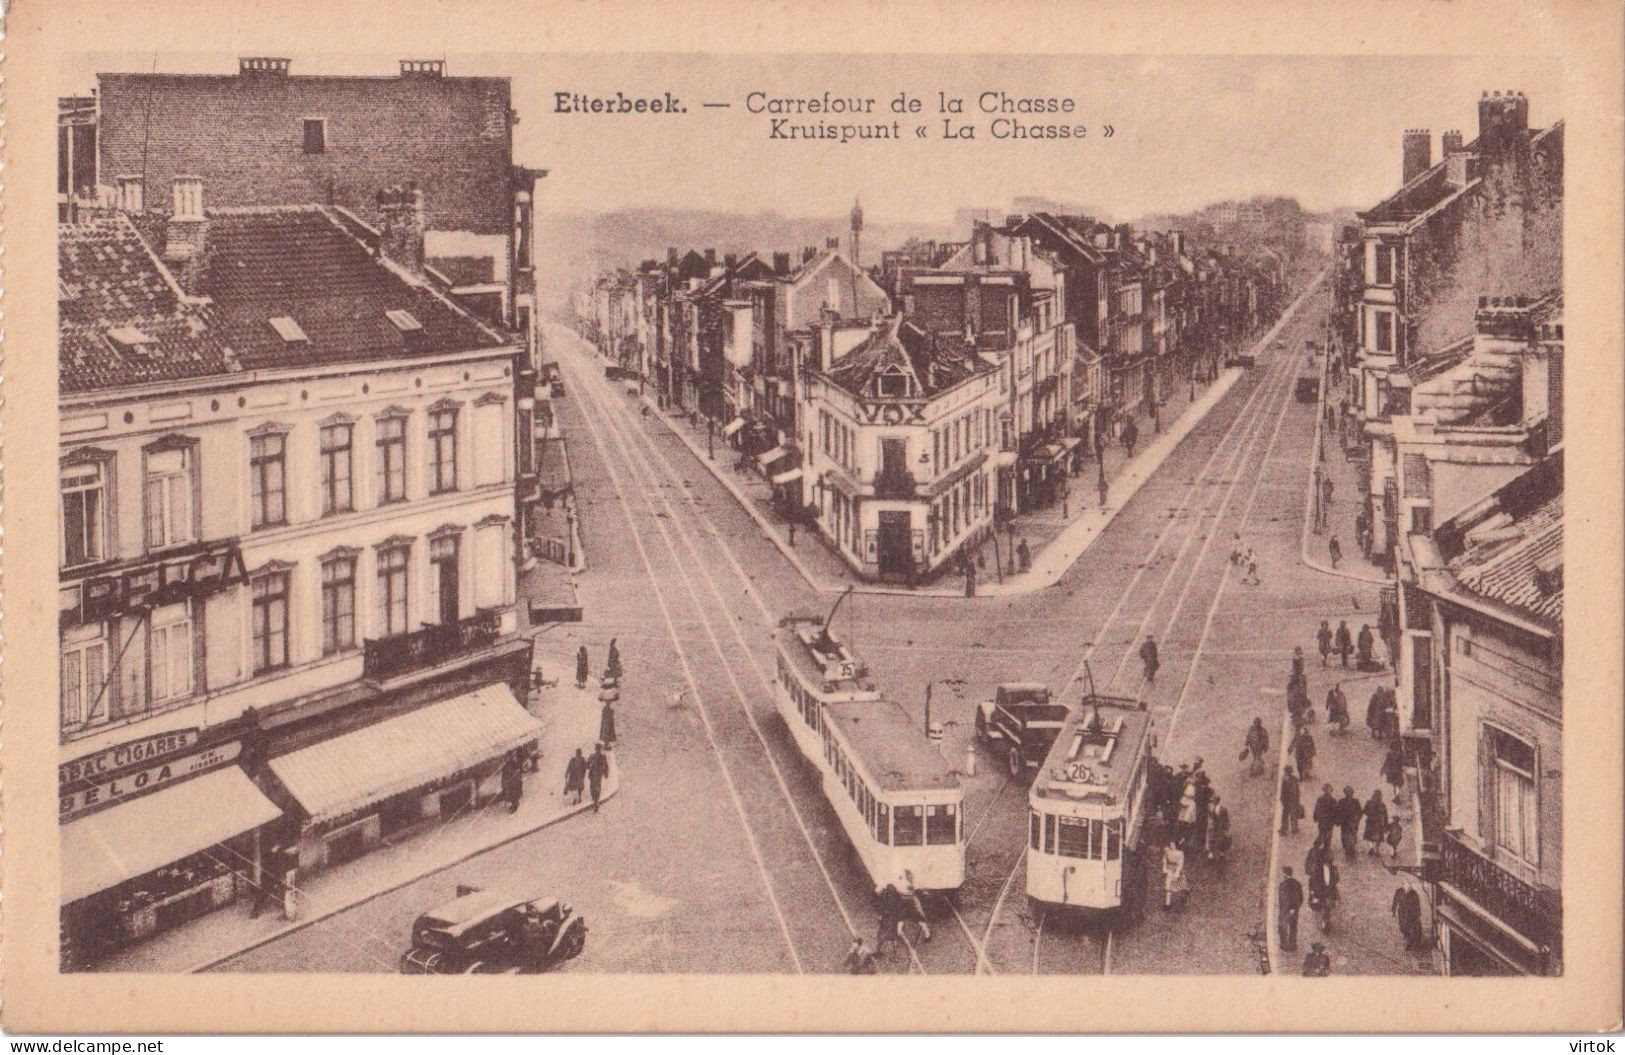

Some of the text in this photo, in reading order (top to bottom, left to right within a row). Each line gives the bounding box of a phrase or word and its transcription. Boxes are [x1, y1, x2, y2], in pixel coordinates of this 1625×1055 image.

[859, 402, 928, 425] VOX
[113, 734, 188, 767] CIGARES
[1071, 763, 1087, 780] 26
